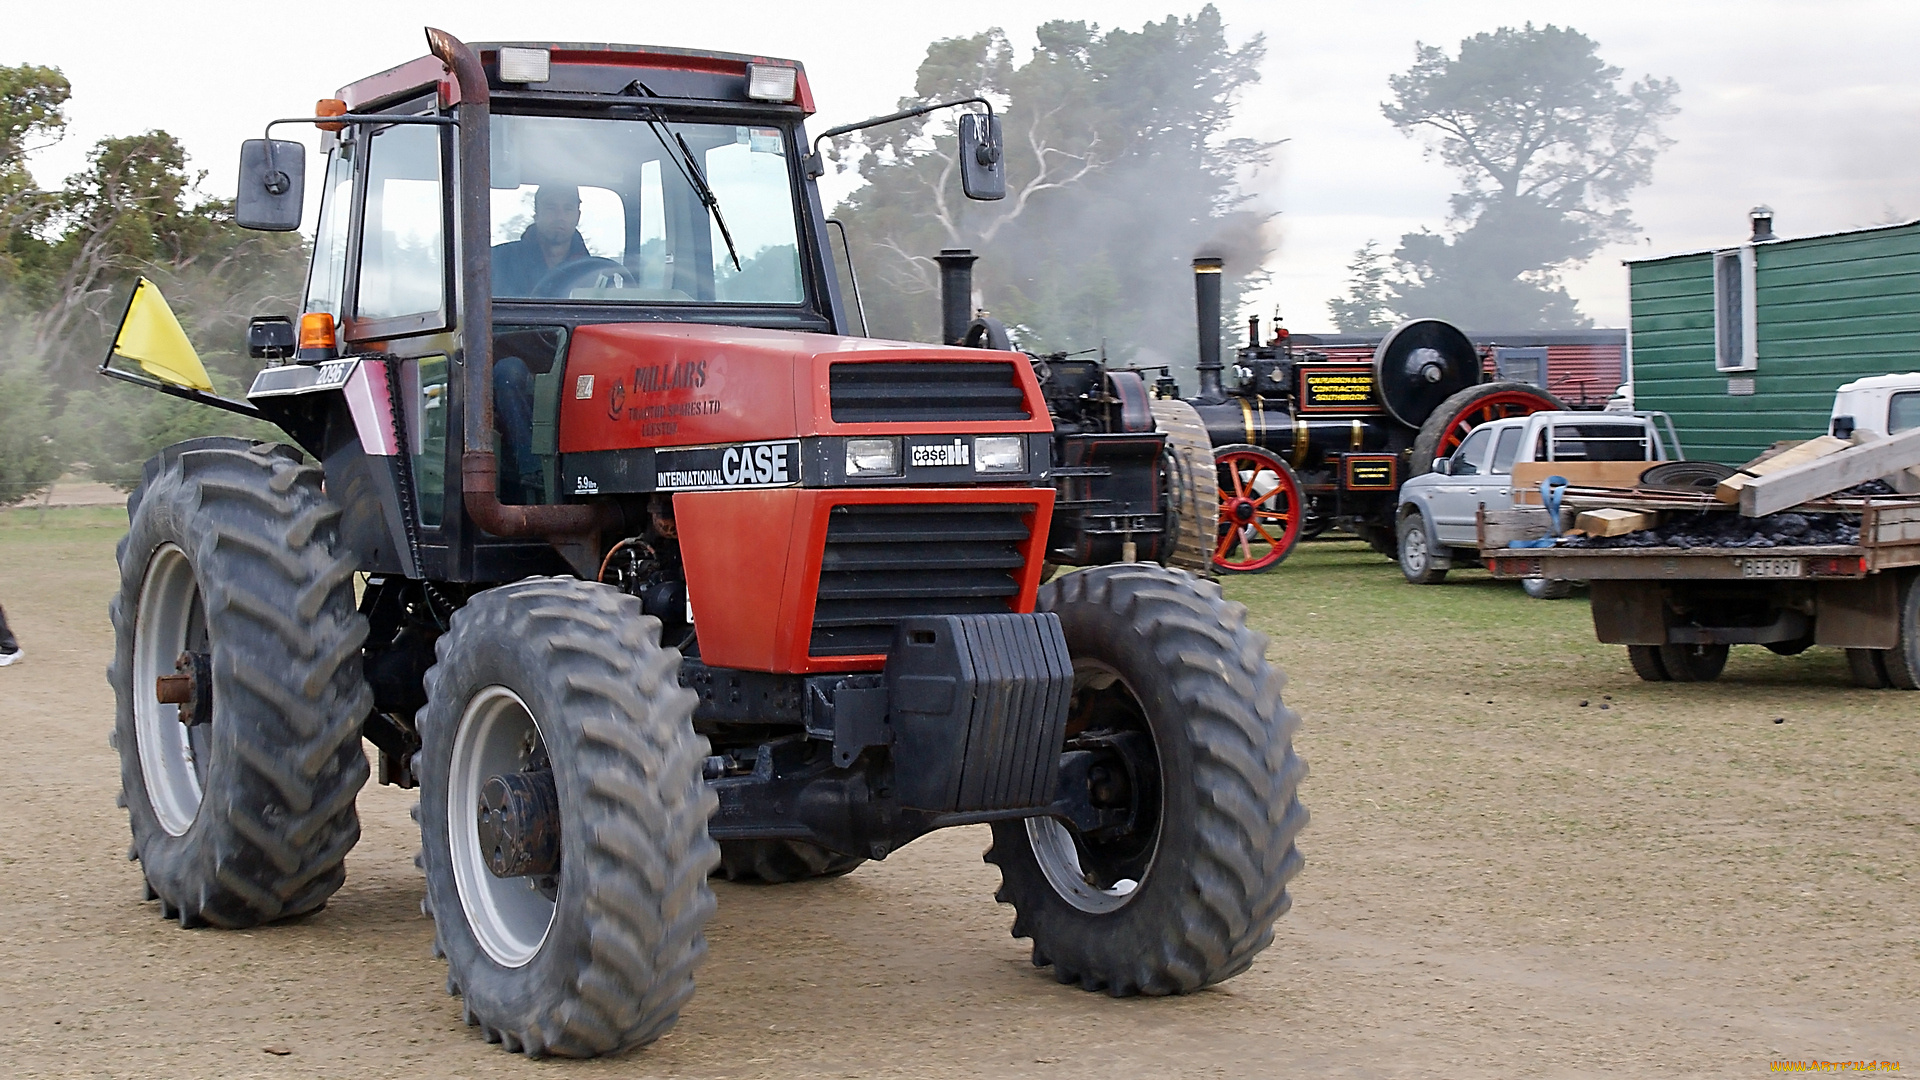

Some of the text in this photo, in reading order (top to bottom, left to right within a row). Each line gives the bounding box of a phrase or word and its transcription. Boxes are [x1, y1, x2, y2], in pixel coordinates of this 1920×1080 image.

[316, 363, 345, 385] 2096
[633, 360, 707, 394] MILLARS
[703, 400, 721, 415] LTD
[657, 444, 789, 487] INTERNATIONAL CASE
